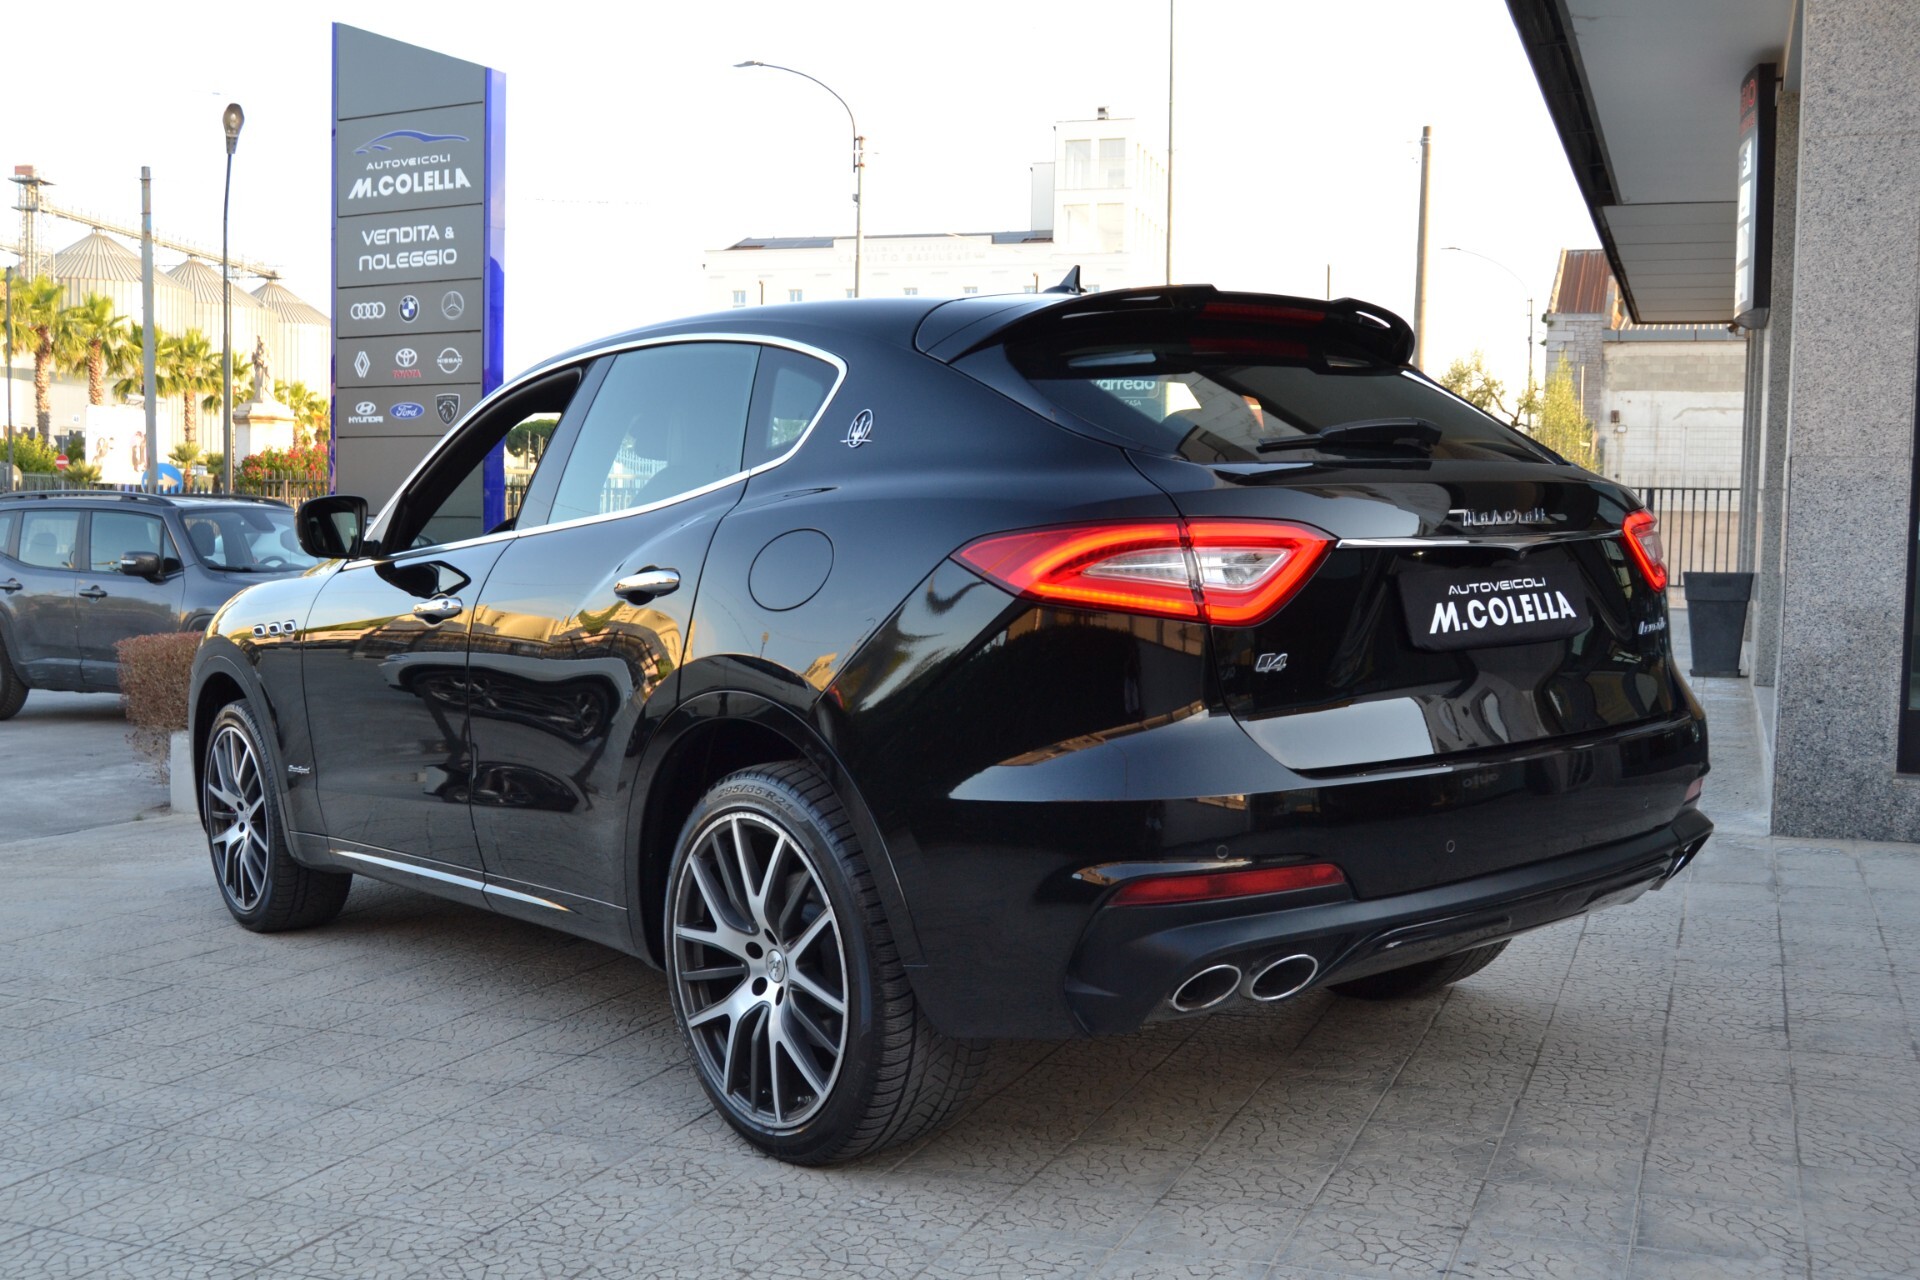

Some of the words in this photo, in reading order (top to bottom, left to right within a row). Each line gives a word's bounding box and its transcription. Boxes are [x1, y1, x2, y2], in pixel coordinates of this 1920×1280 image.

[366, 153, 451, 171] AUTOVEICOLI
[348, 167, 472, 200] M.COLELLA
[361, 224, 440, 246] VENDITA
[444, 226, 455, 240] &
[358, 248, 458, 272] NOLEGGIO
[348, 415, 384, 424] HYUNDAI
[395, 403, 419, 417] Ford
[1448, 577, 1547, 596] AUTOVEICOLI
[1429, 590, 1578, 635] M.COLELLA
